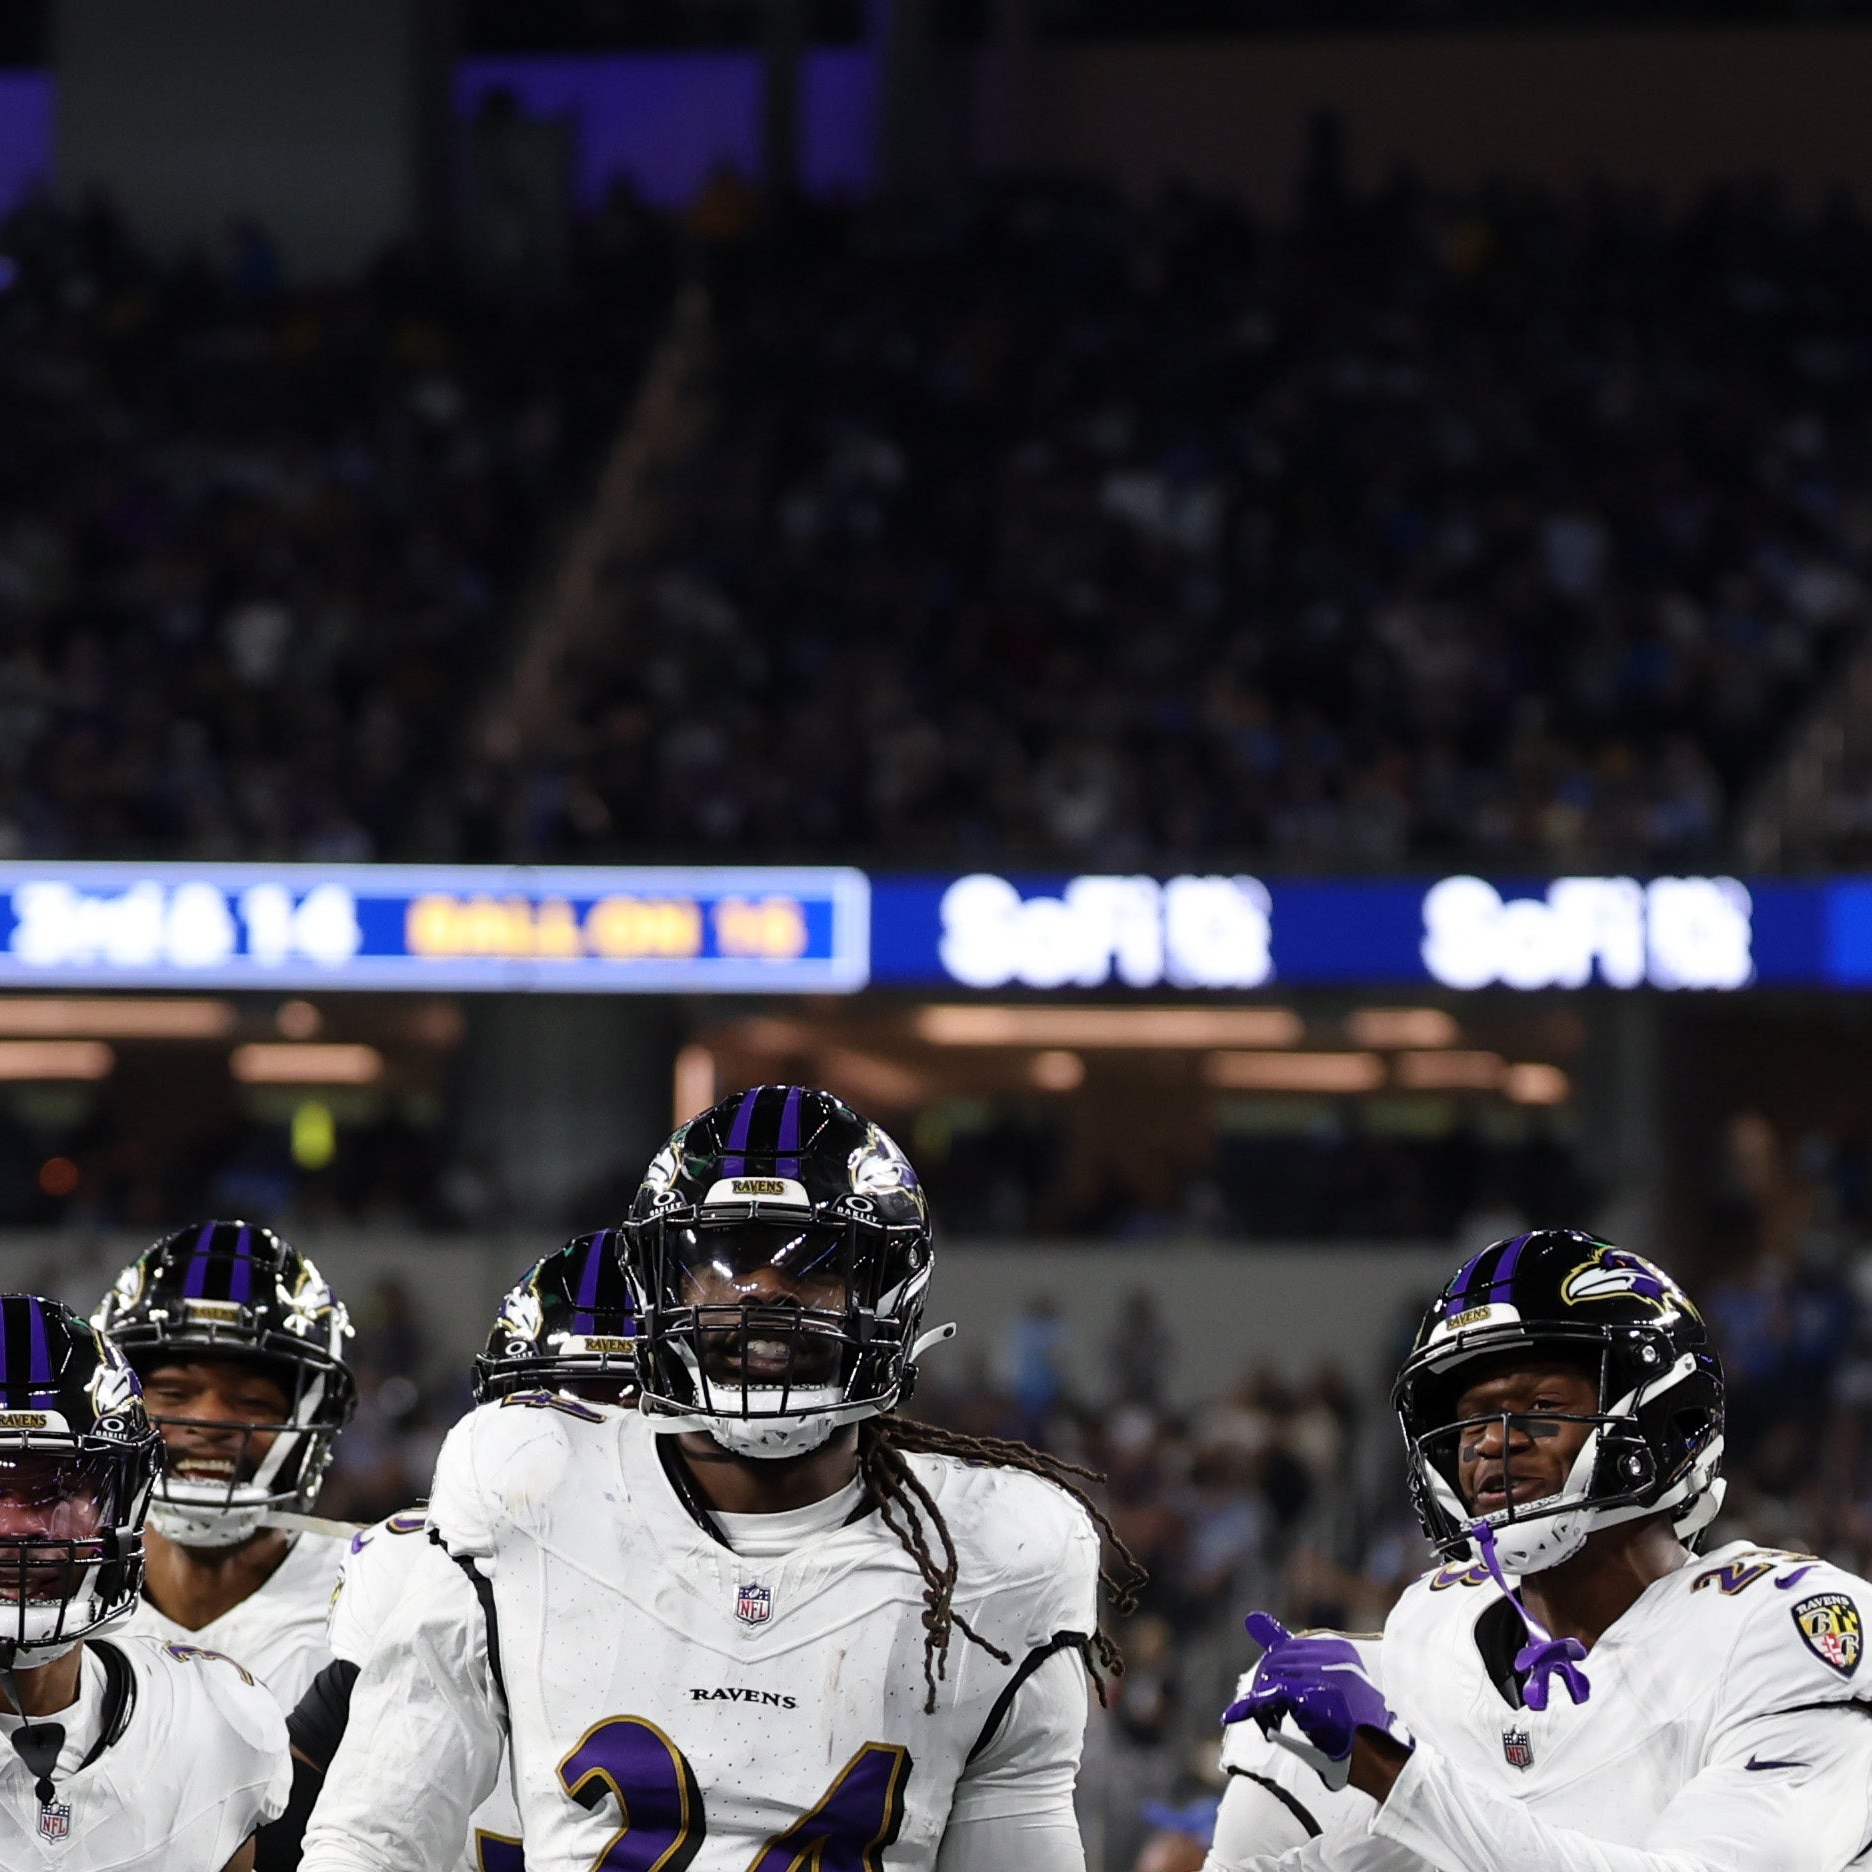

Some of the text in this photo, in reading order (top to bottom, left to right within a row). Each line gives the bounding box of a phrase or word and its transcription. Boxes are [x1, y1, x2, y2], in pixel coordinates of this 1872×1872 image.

[732, 1180, 784, 1195] RAVENS
[837, 1206, 878, 1223] OAKLEY
[584, 1338, 635, 1352] RAVENS
[1795, 1595, 1850, 1615] RAVENS
[688, 1687, 798, 1711] RAVENS
